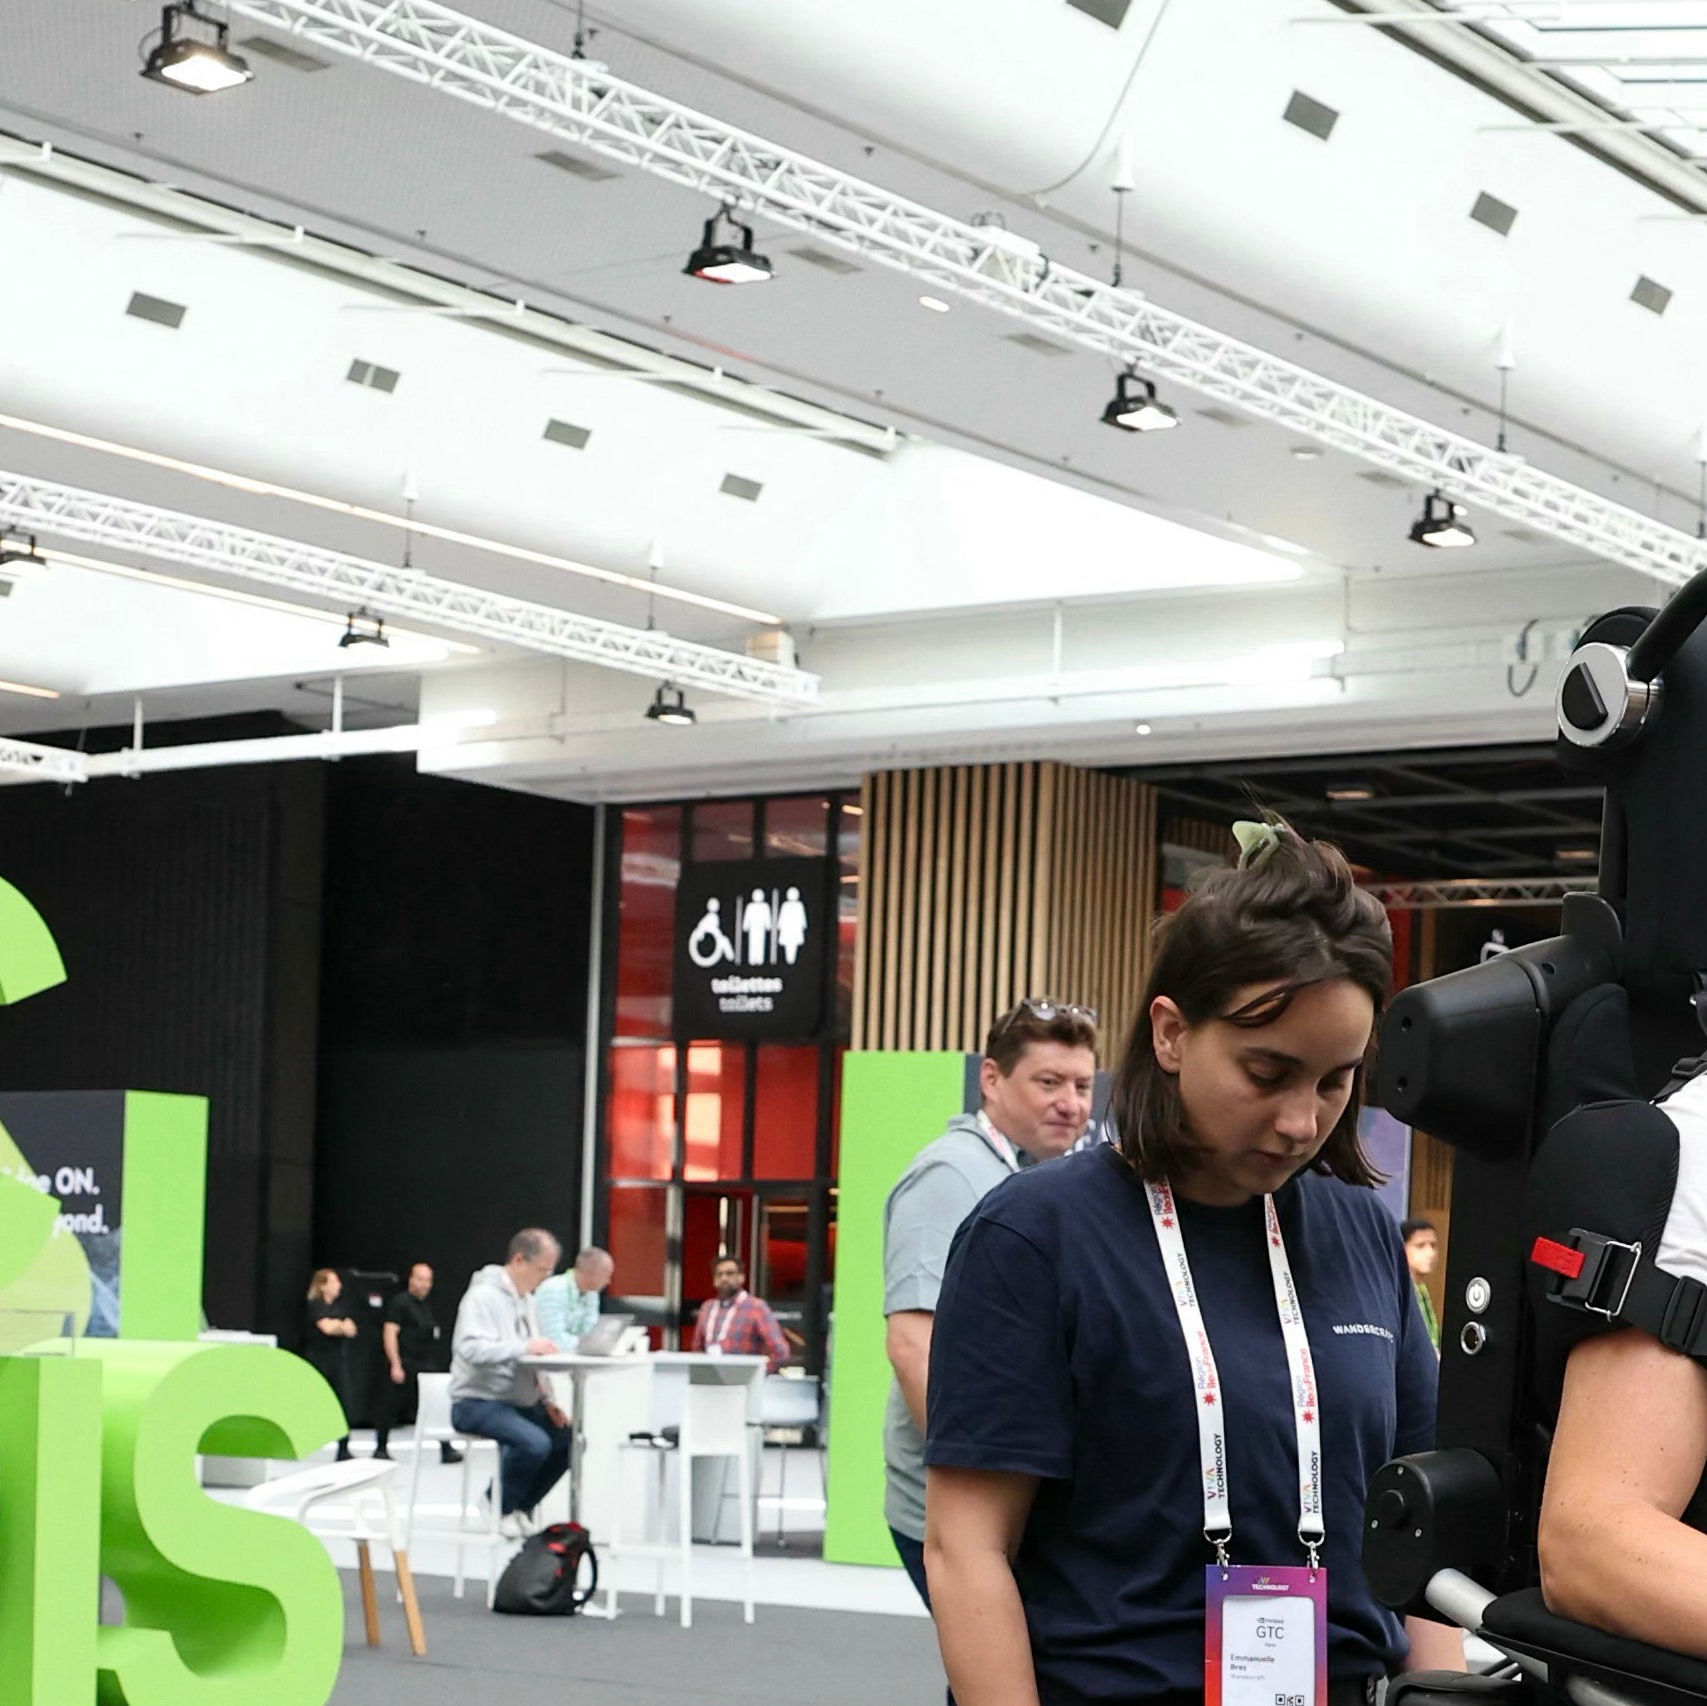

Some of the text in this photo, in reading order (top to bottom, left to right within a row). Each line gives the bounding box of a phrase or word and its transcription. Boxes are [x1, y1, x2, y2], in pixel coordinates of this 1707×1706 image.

[52, 1203, 110, 1240] yond.
[1214, 1433, 1226, 1500] TECHNOLOGY
[1311, 1450, 1320, 1514] TECHNOLOGY
[1255, 1625, 1285, 1640] GTC
